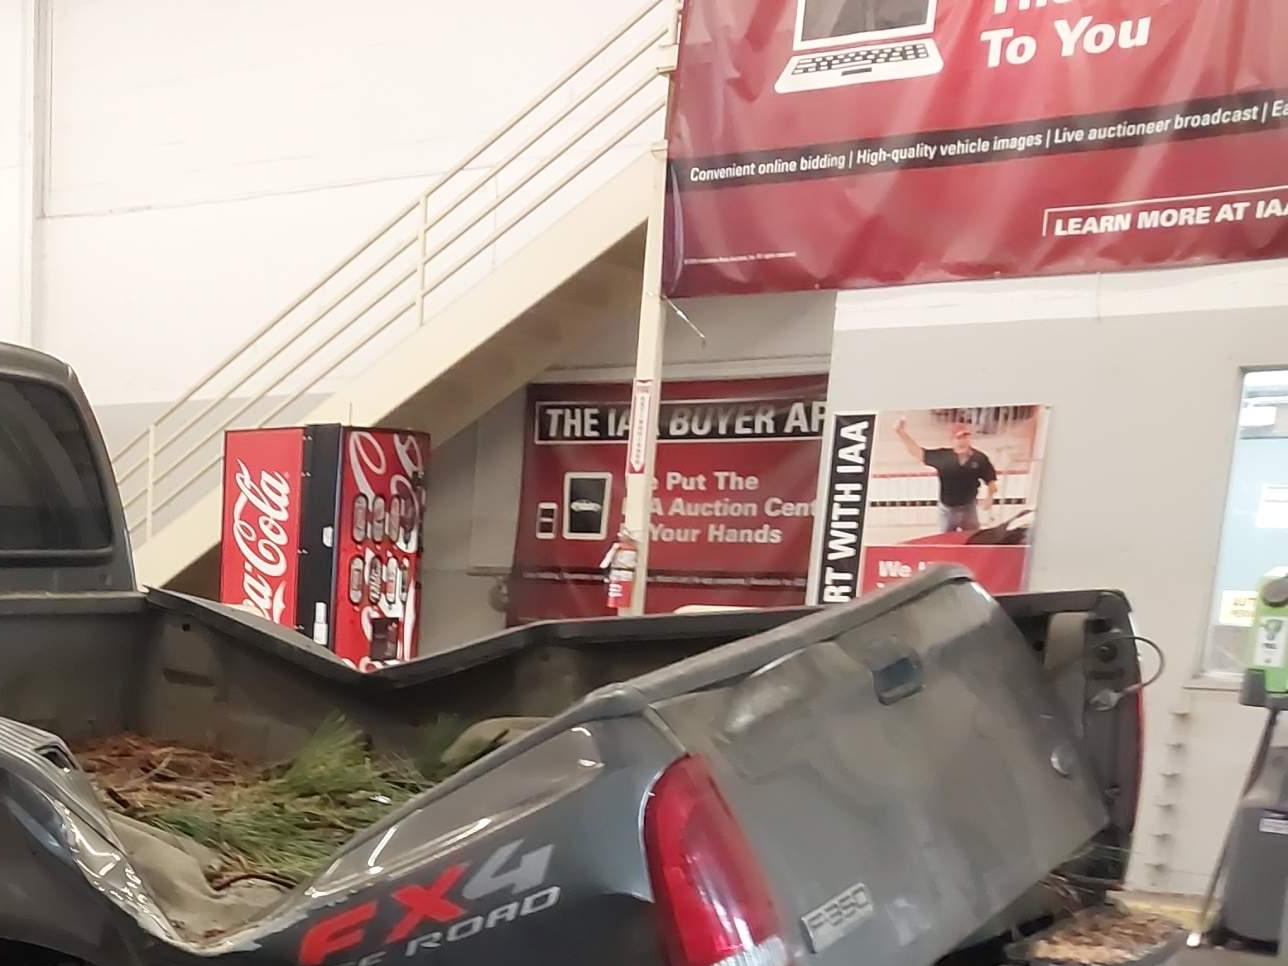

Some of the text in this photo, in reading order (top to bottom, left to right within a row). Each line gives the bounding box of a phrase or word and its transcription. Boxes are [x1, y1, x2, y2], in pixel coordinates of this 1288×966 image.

[980, 16, 1151, 68] To You
[690, 163, 755, 181] Convenient
[758, 158, 797, 175] online
[800, 153, 846, 171] bidding
[856, 142, 938, 166] High-quality
[940, 138, 990, 156] vehicle
[993, 133, 1043, 151] images
[1054, 128, 1085, 144] Live
[1088, 119, 1171, 140] auctioneer
[1174, 105, 1258, 131] broadcast
[1054, 199, 1288, 237] LEARN MORE AT IA
[546, 408, 600, 437] THE
[669, 404, 776, 436] BUYER
[837, 421, 869, 473] IAA
[666, 472, 707, 491] Put
[713, 472, 759, 490] The
[669, 497, 757, 517] Auction
[827, 483, 863, 560] WITH
[708, 524, 783, 543] Hands
[878, 560, 912, 577] We
[405, 886, 561, 957] ROAD
